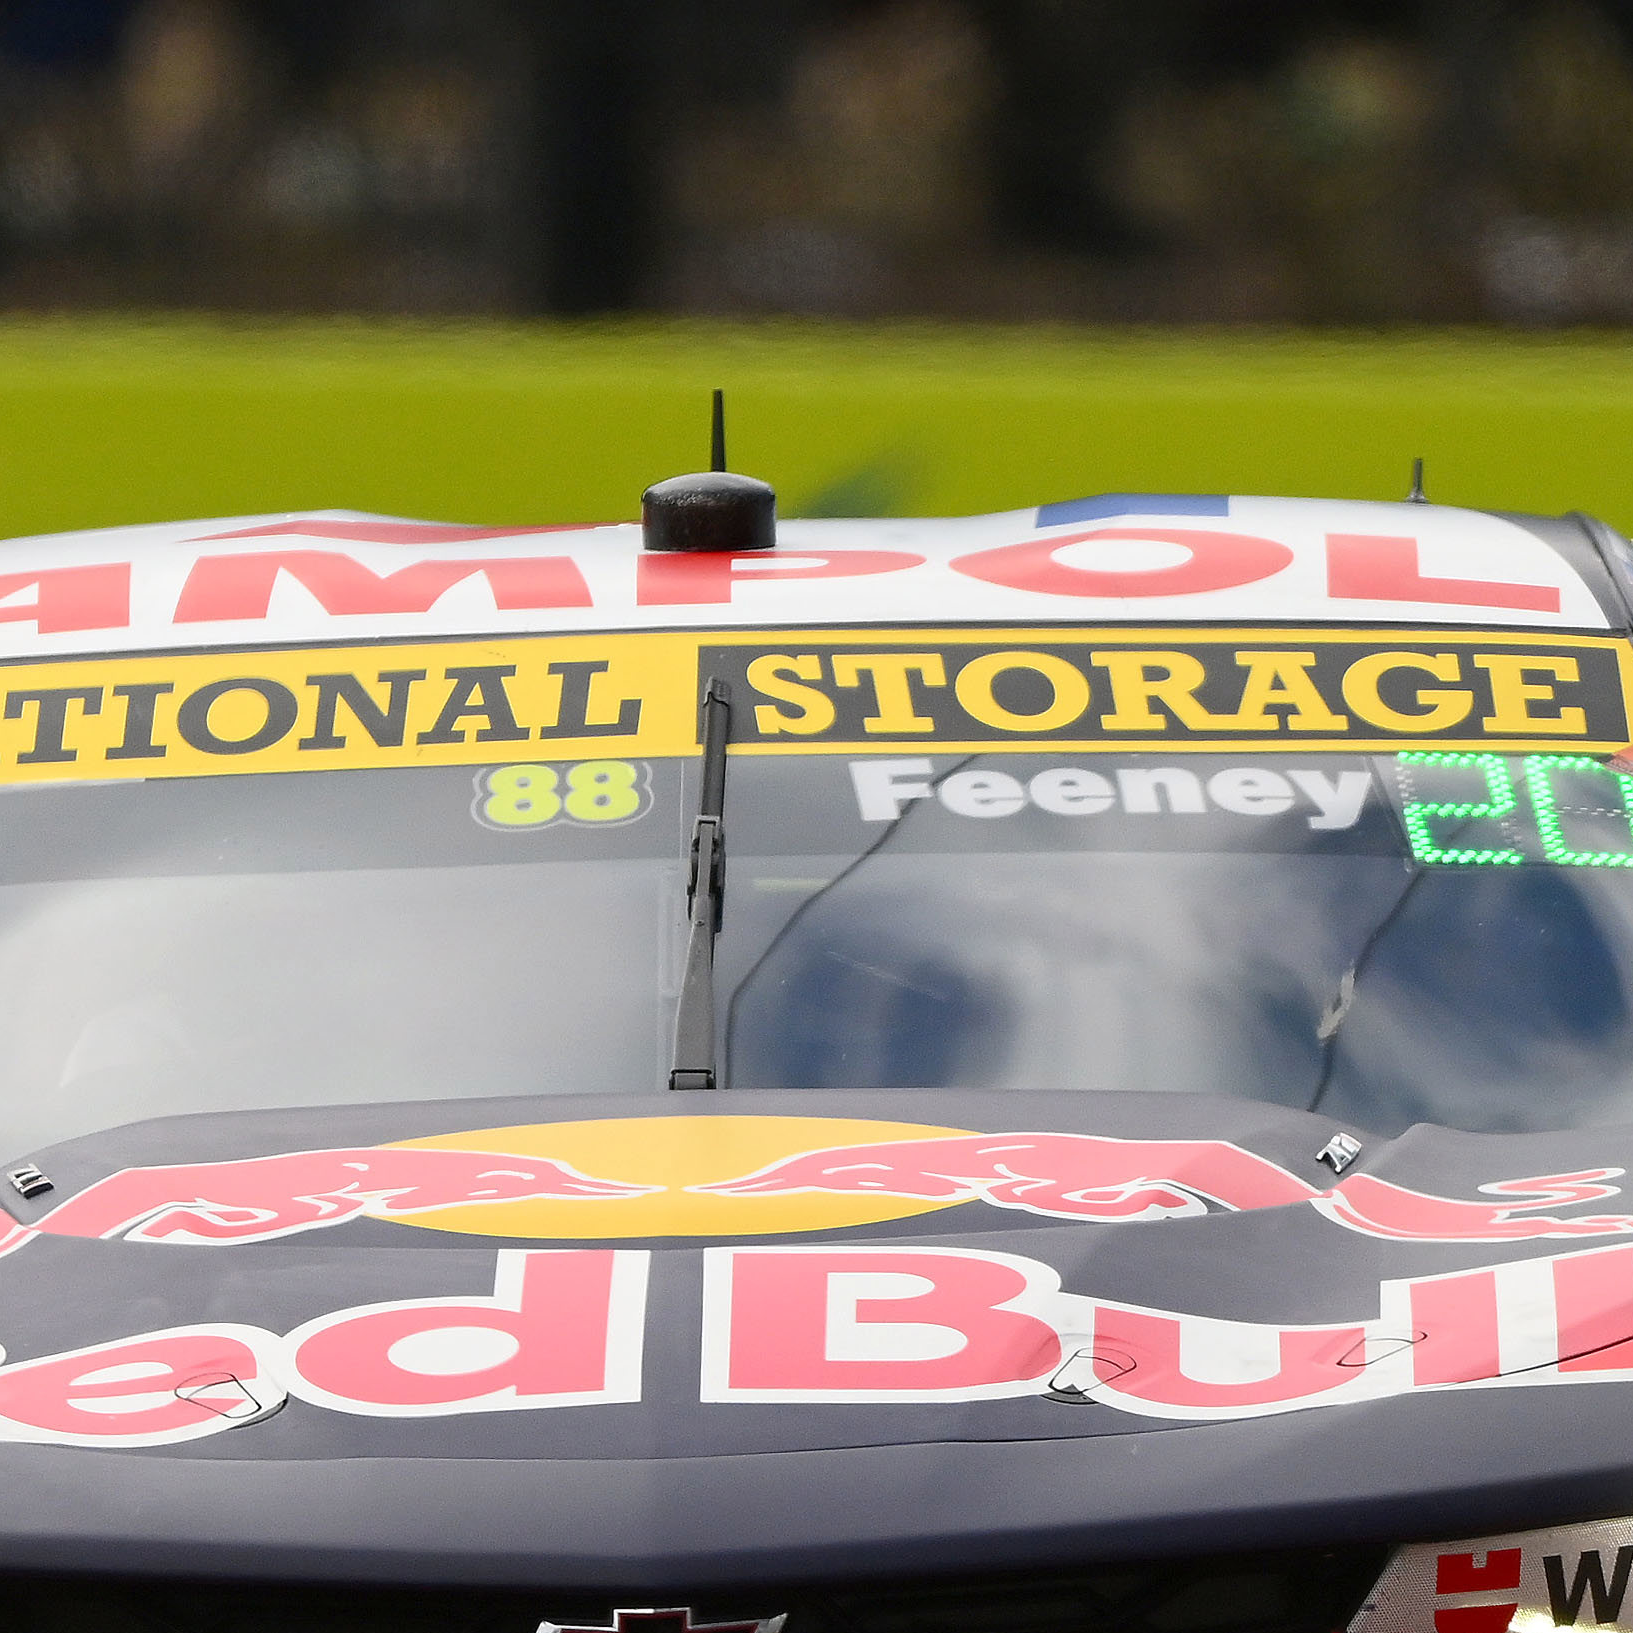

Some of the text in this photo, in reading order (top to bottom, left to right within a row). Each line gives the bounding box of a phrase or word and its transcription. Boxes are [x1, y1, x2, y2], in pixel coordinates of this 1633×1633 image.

[746, 650, 1586, 735] STORAGE
[479, 760, 647, 825] 88
[849, 758, 1372, 831] Feeney
